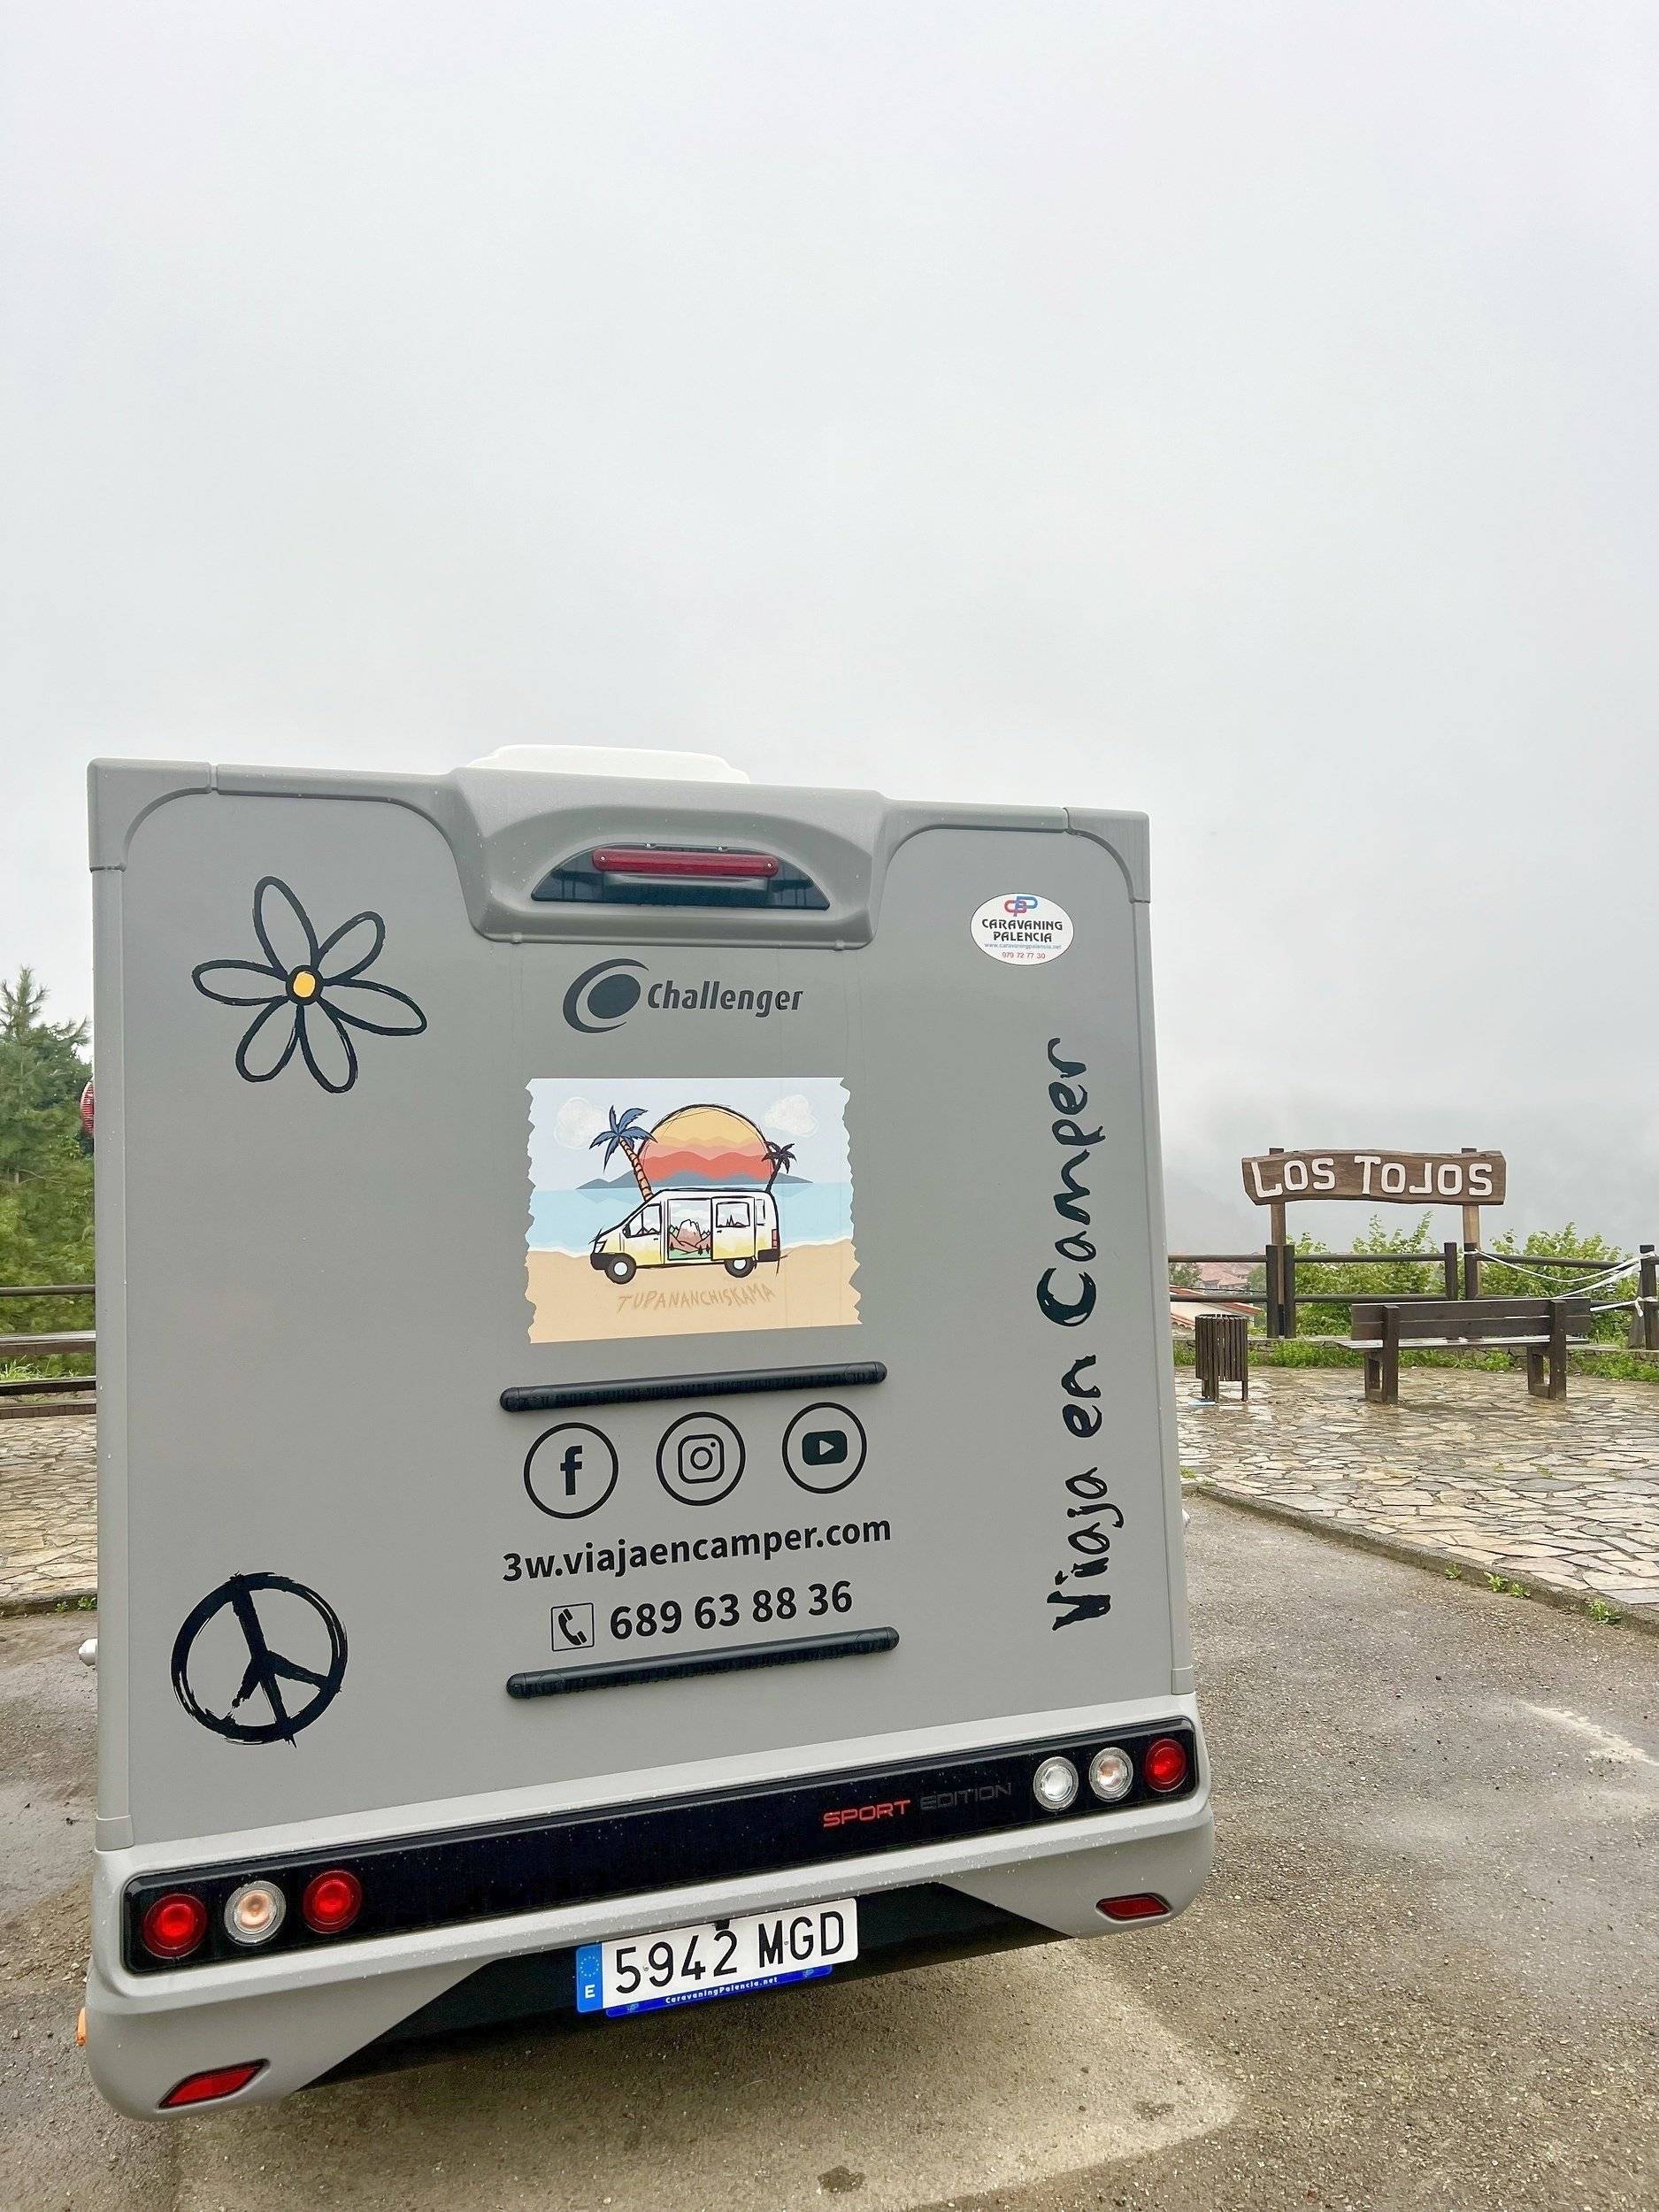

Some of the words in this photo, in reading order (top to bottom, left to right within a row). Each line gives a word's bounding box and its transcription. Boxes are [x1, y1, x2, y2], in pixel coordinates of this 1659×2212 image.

[981, 918, 1063, 931] CARAVANING
[993, 931, 1052, 943] PALENCIA
[647, 979, 804, 1018] Challenger
[1036, 1037, 1106, 1327] Camper
[1250, 1157, 1336, 1199] LOS
[1354, 1155, 1494, 1196] TOJOS
[618, 1282, 777, 1312] TUPANANCHISKAMA
[1062, 1354, 1103, 1438] en
[503, 1519, 892, 1581] 3w.viajaencamper.com
[1047, 1467, 1124, 1632] Viaja
[610, 1600, 682, 1640] 689
[694, 1593, 740, 1630] 63
[752, 1586, 797, 1623] 88
[808, 1580, 853, 1617] 36
[823, 1799, 911, 1828] SPORT
[919, 1782, 1012, 1811] EDITION
[615, 1930, 738, 1994] 5942
[757, 1909, 845, 1969] MGD
[584, 1984, 595, 1999] E
[664, 1976, 779, 2005] CaravaningPalencia.net
